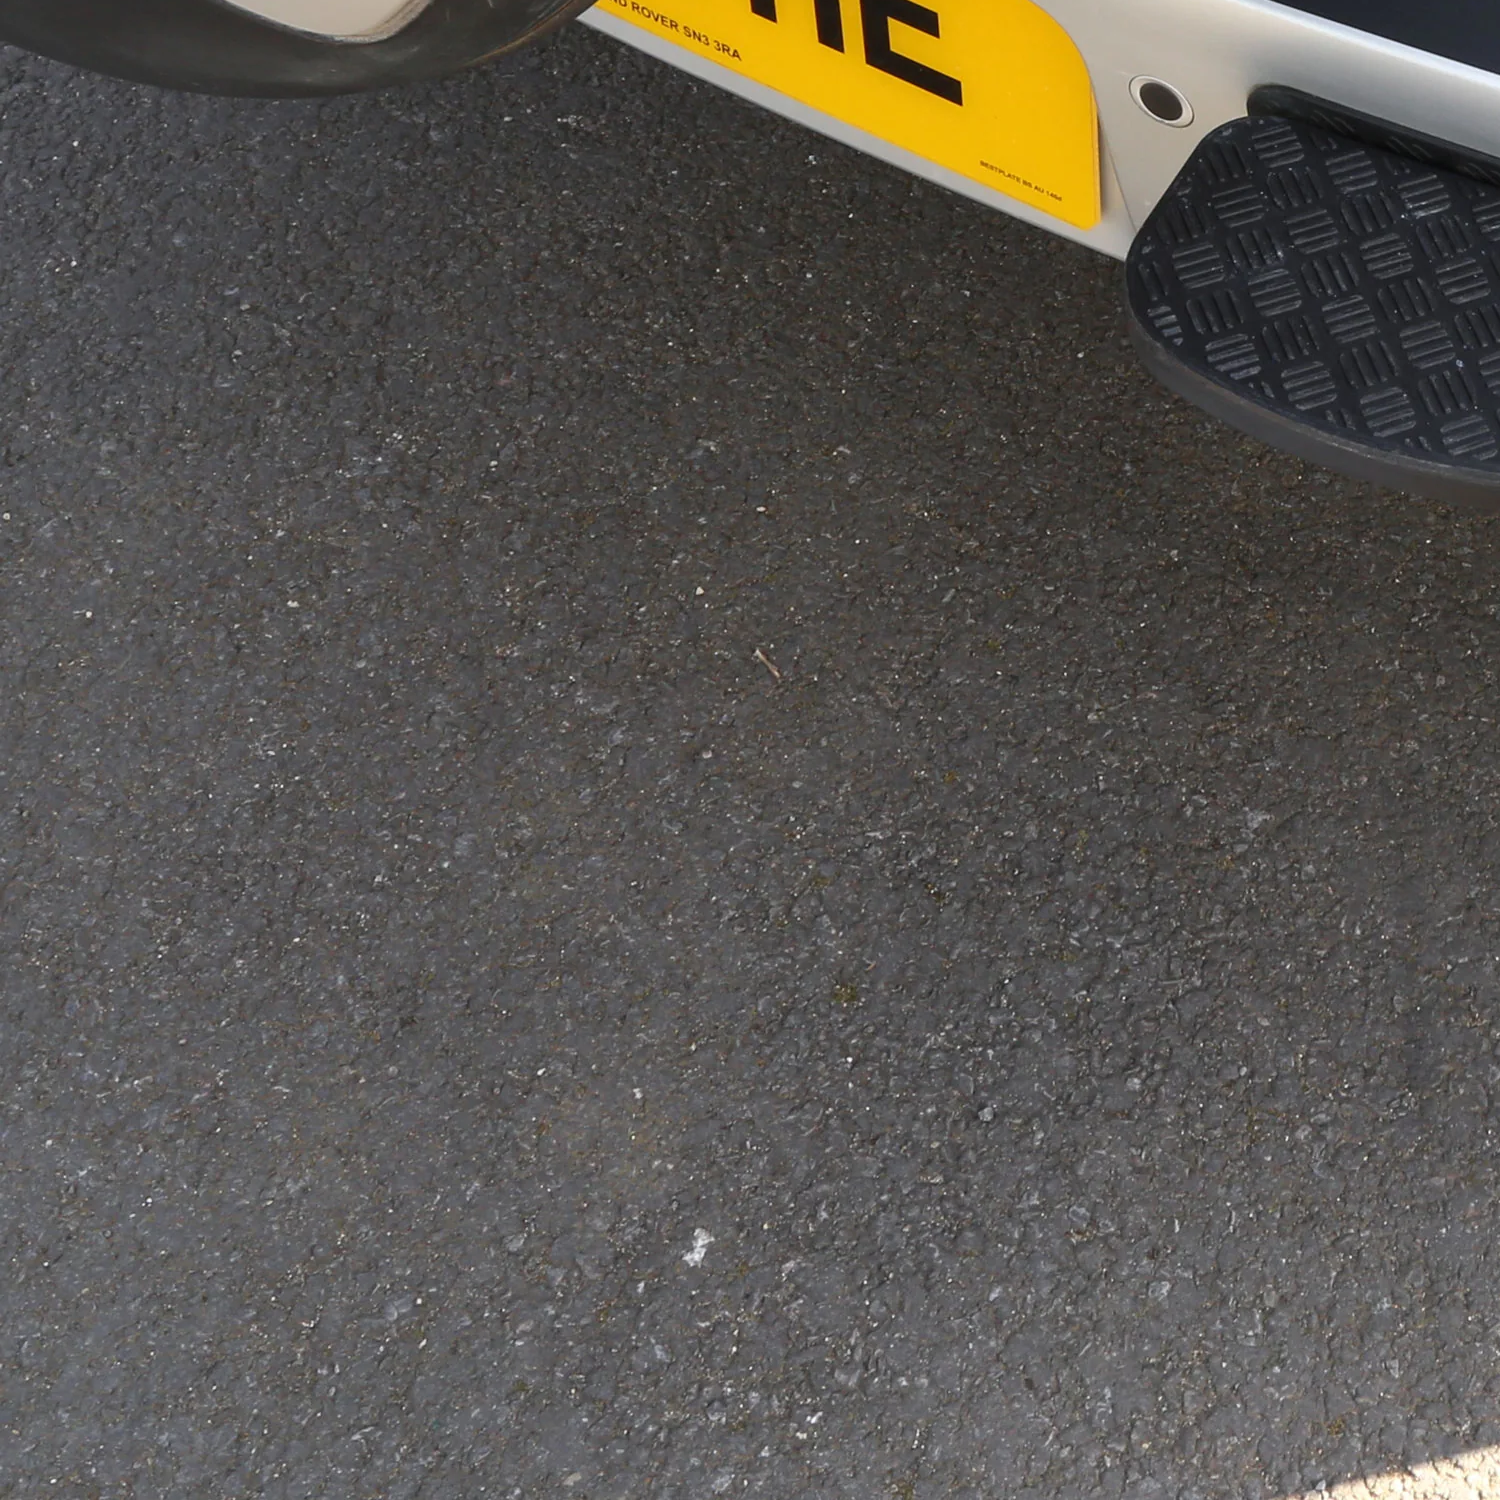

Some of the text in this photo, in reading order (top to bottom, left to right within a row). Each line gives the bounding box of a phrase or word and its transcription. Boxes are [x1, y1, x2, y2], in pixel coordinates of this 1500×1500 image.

[631, 1, 680, 33] ROVER
[683, 25, 710, 46] SN3
[713, 40, 742, 62] 3RA
